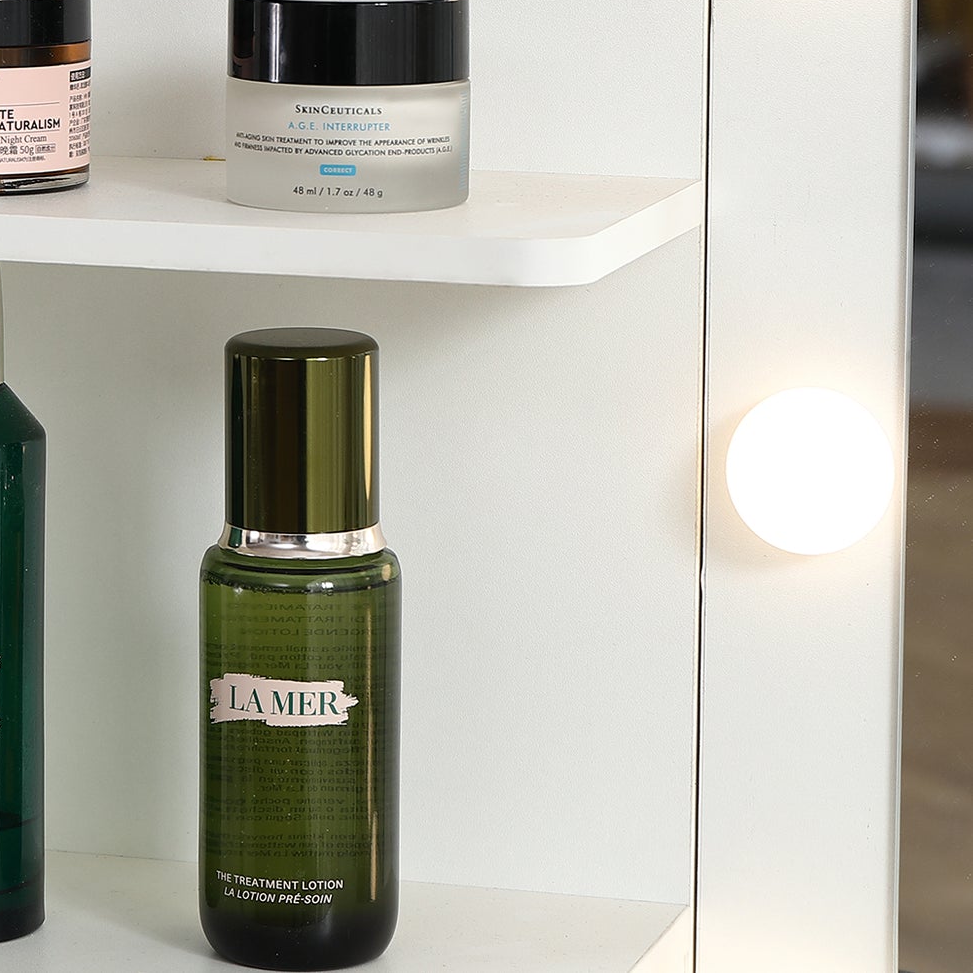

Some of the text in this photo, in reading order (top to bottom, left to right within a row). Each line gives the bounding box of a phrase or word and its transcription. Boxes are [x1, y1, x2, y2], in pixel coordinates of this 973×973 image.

[288, 121, 391, 132] A.G.E. INTERRUPTER
[0, 135, 23, 146] Night
[23, 134, 47, 143] Cream
[261, 134, 275, 143] SKIN
[276, 136, 312, 145] TREATMENT
[314, 138, 324, 146] TO
[19, 145, 34, 156] 50g
[263, 145, 293, 154] IMPACTED
[295, 147, 303, 155] BY
[304, 148, 343, 156] ADVANCED
[387, 147, 435, 156] END-PRODUCTS
[293, 186, 305, 195] 48
[306, 186, 317, 196] ml
[327, 188, 340, 196] 1.7
[343, 189, 354, 197] oz
[363, 188, 375, 197] 48
[377, 189, 384, 198] g
[229, 685, 341, 716] LA MER
[216, 870, 344, 890] THE TREATMENT LOTION
[224, 887, 333, 904] LA LOTION PRÉ-SOIN
